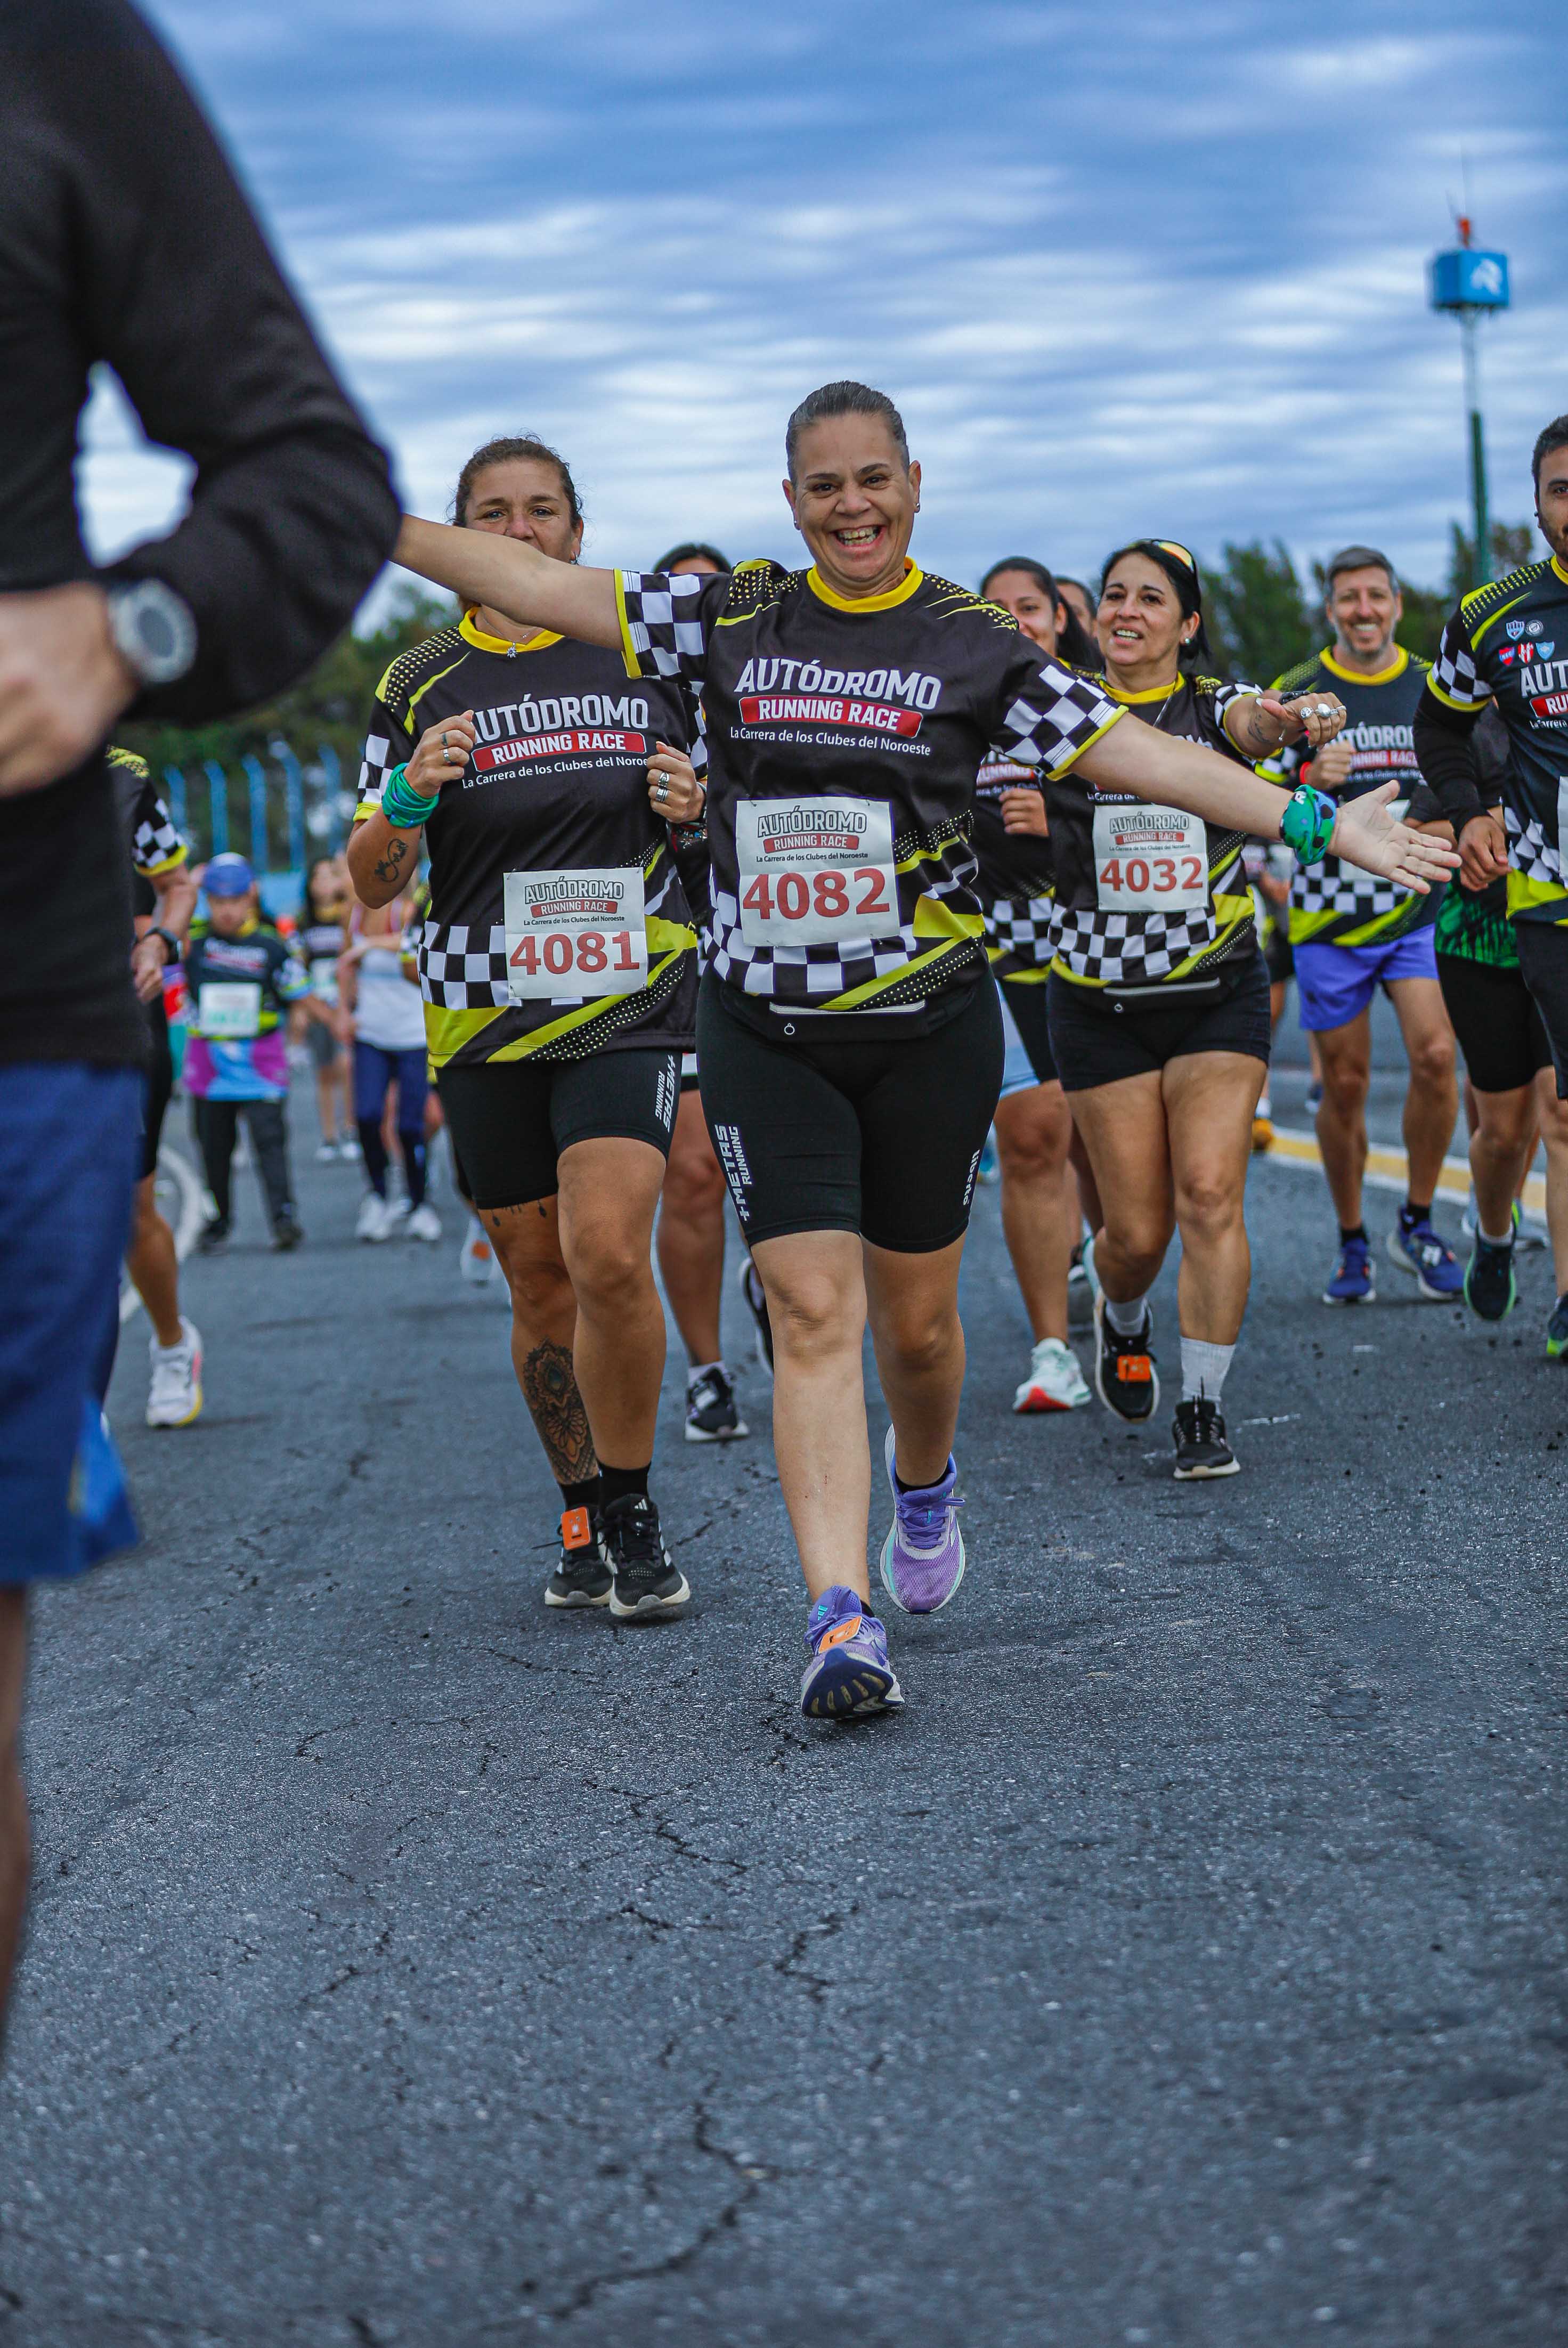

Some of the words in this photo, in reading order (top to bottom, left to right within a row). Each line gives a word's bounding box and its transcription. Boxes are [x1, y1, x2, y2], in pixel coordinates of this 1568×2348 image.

[734, 657, 942, 710] AUTÓDROMO
[758, 698, 843, 720] RUNNING
[848, 703, 901, 730] RACE
[491, 735, 573, 765] RUNNING
[577, 733, 626, 750] RACE
[730, 727, 739, 738] La
[740, 728, 775, 741] Carrera
[778, 729, 793, 741] de
[796, 730, 813, 743] los
[816, 733, 856, 747] Clubes
[858, 735, 878, 748] del
[881, 739, 931, 755] Noroeste
[462, 778, 474, 789] La
[476, 770, 516, 785] Carrera
[518, 767, 533, 777] de
[535, 763, 552, 775] los
[554, 760, 593, 773] Clubes
[596, 757, 614, 767] del
[616, 756, 648, 767] Noroe
[758, 805, 867, 838] AUTÓDROMO
[1109, 811, 1189, 833] AUTÓDROMO
[1123, 832, 1156, 843] RUNNING
[1159, 832, 1177, 841] RACE
[774, 835, 817, 851] RUNNING
[820, 836, 848, 848] RACE
[525, 876, 624, 904] AUTÓDROMO
[1099, 856, 1203, 892] 4032
[541, 901, 581, 915] RUNNING
[584, 901, 607, 912] RACE
[743, 868, 890, 920] 4082
[510, 931, 639, 975] 4081
[655, 1071, 665, 1120] RUNNING
[729, 1126, 753, 1185] RUNNING
